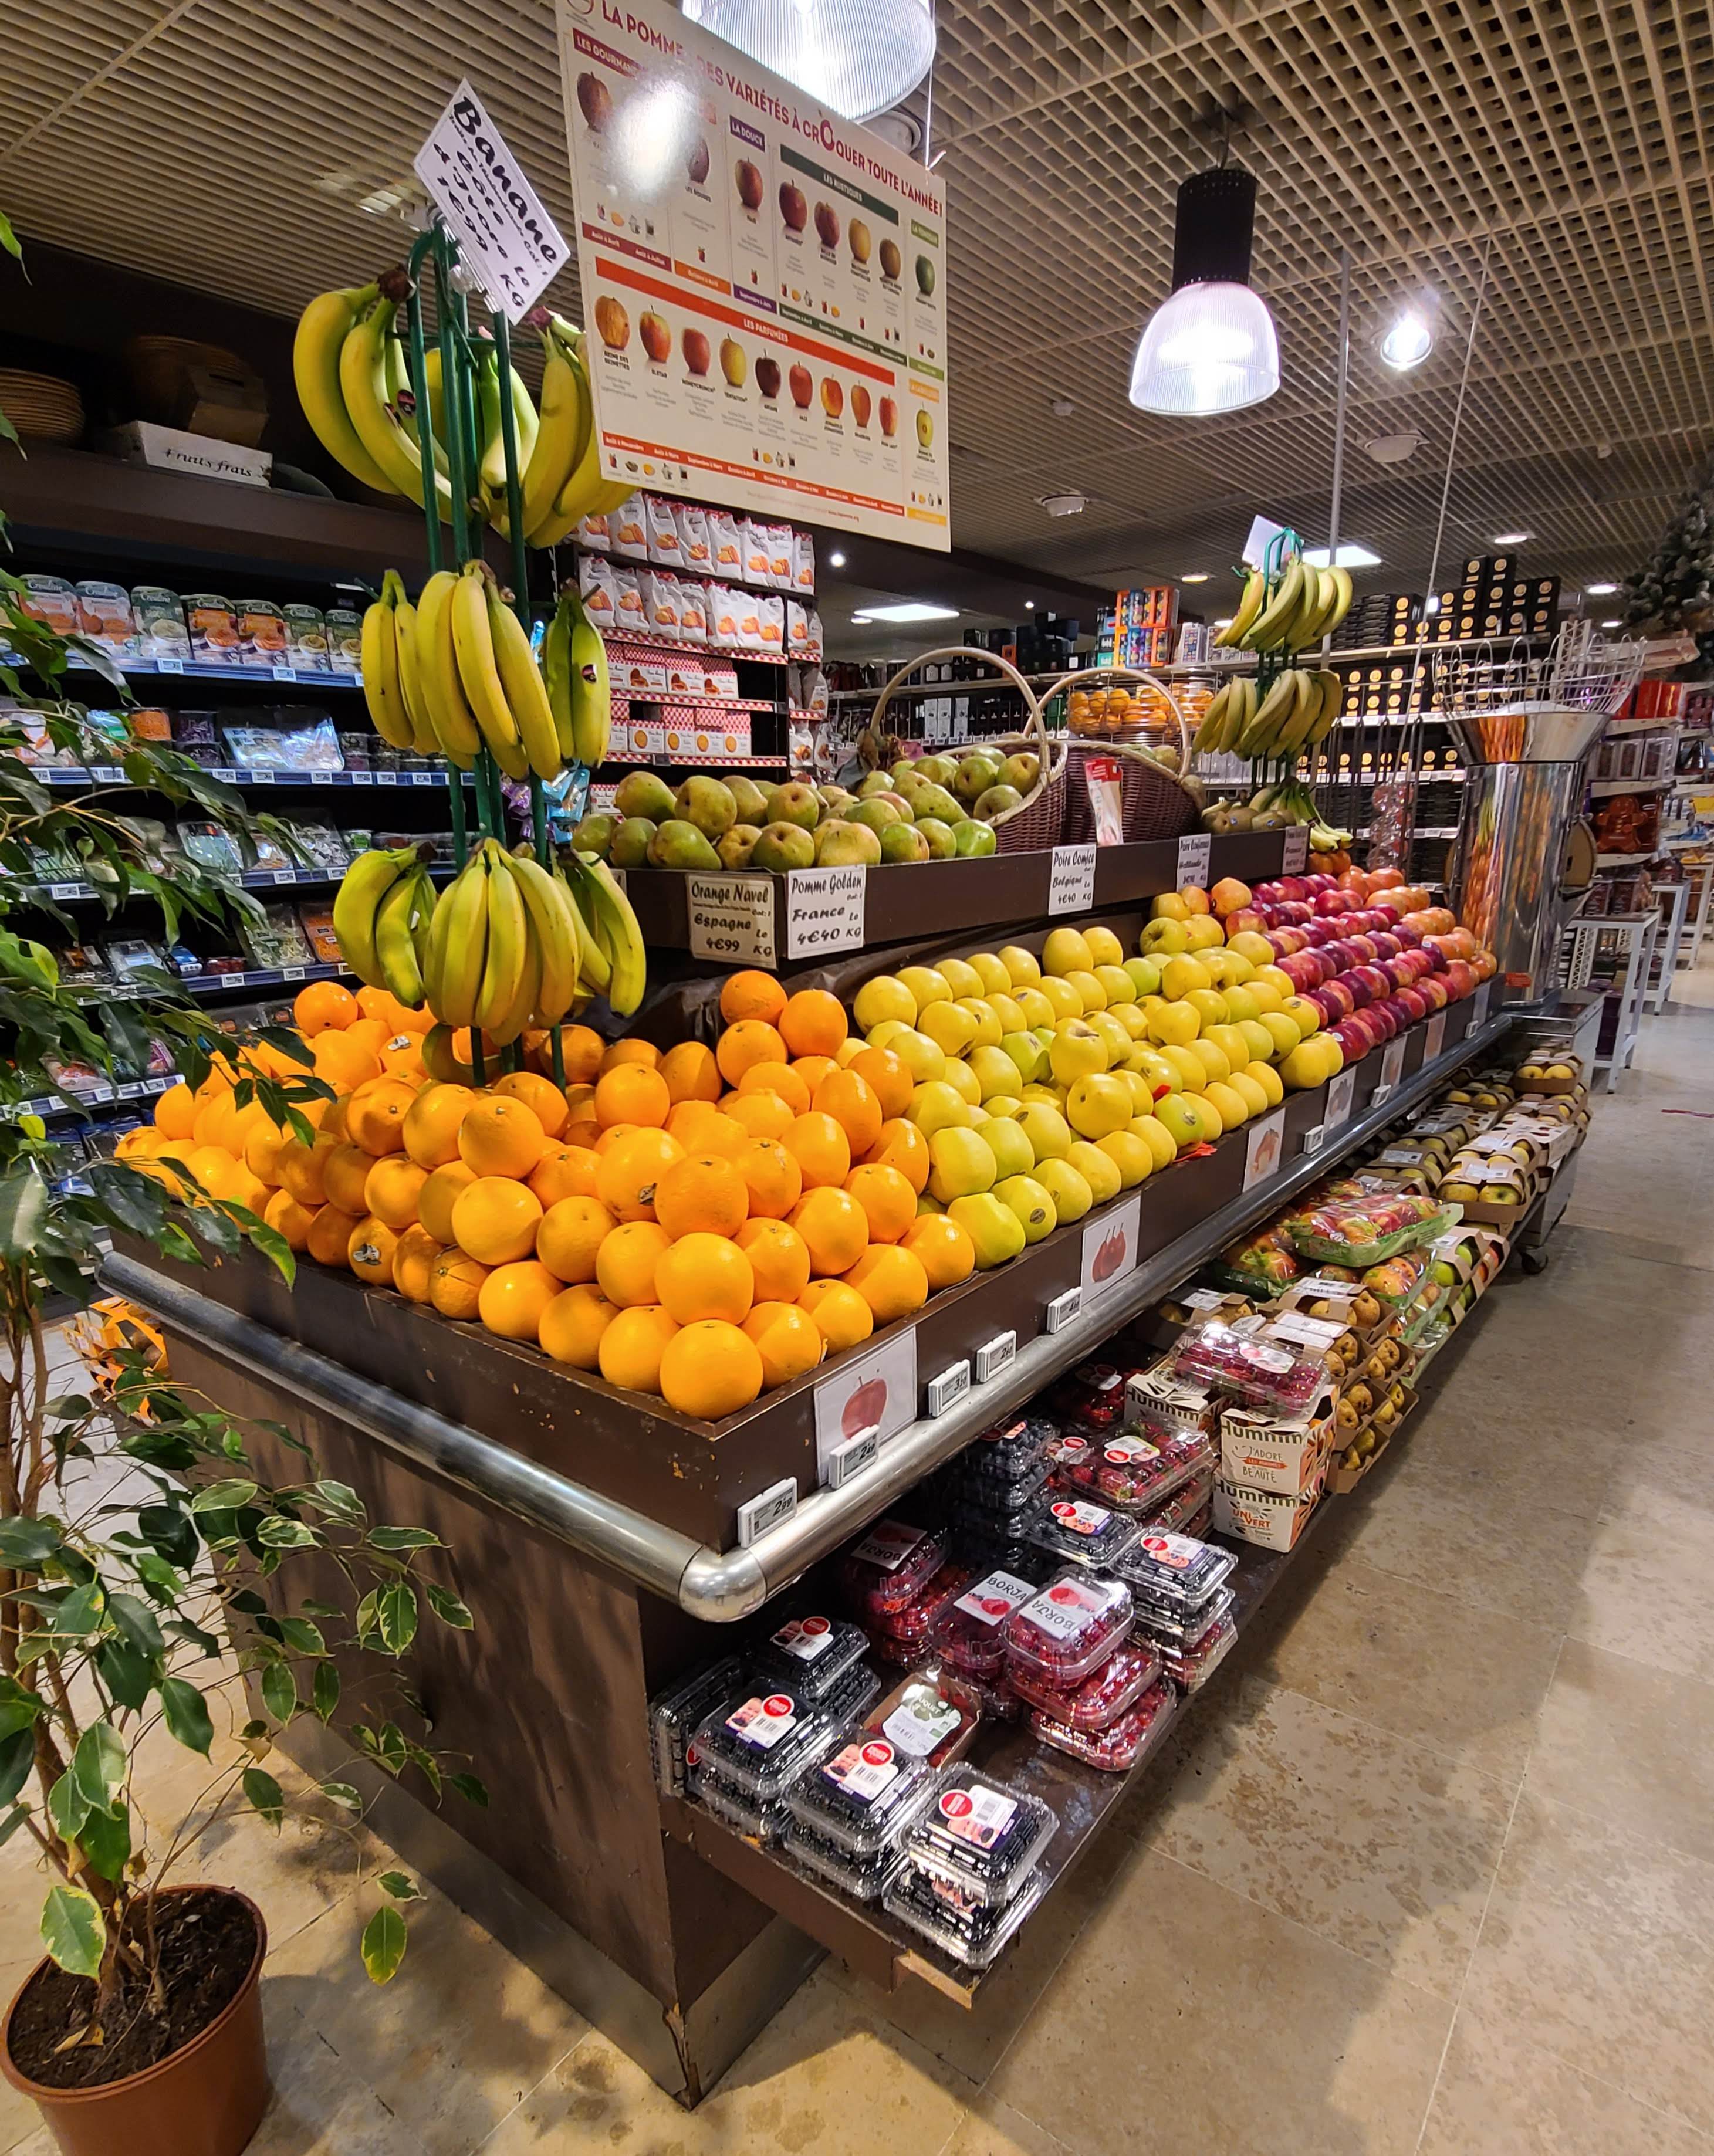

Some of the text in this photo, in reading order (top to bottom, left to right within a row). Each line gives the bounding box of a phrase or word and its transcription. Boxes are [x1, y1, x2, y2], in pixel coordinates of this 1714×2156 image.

[576, 35, 592, 53] LES
[602, 0, 623, 29] LA
[726, 73, 789, 125] VARIÉTÉS
[792, 107, 801, 133] À
[803, 111, 866, 171] CROQUER
[867, 158, 899, 192] TOUTE
[731, 120, 741, 136] LA
[453, 96, 557, 263] Banane
[457, 150, 504, 225] Côte
[823, 172, 833, 187] LES
[499, 274, 525, 306] KG
[743, 317, 755, 330] LES
[161, 448, 253, 478] Fruits frais
[1053, 851, 1071, 867] Poire
[691, 881, 769, 905] Orange Navel
[792, 871, 862, 895] Pomme Golden
[694, 912, 768, 939] Espagne Le
[792, 906, 859, 922] France Le
[706, 936, 772, 958] 4€99 KG
[797, 926, 862, 946] 4€40 KG
[1242, 1465, 1277, 1483] BEAUTÉ
[859, 1542, 903, 1562] BORJA
[986, 1575, 1029, 1602] BORJA
[1030, 1600, 1076, 1631] BORJA
